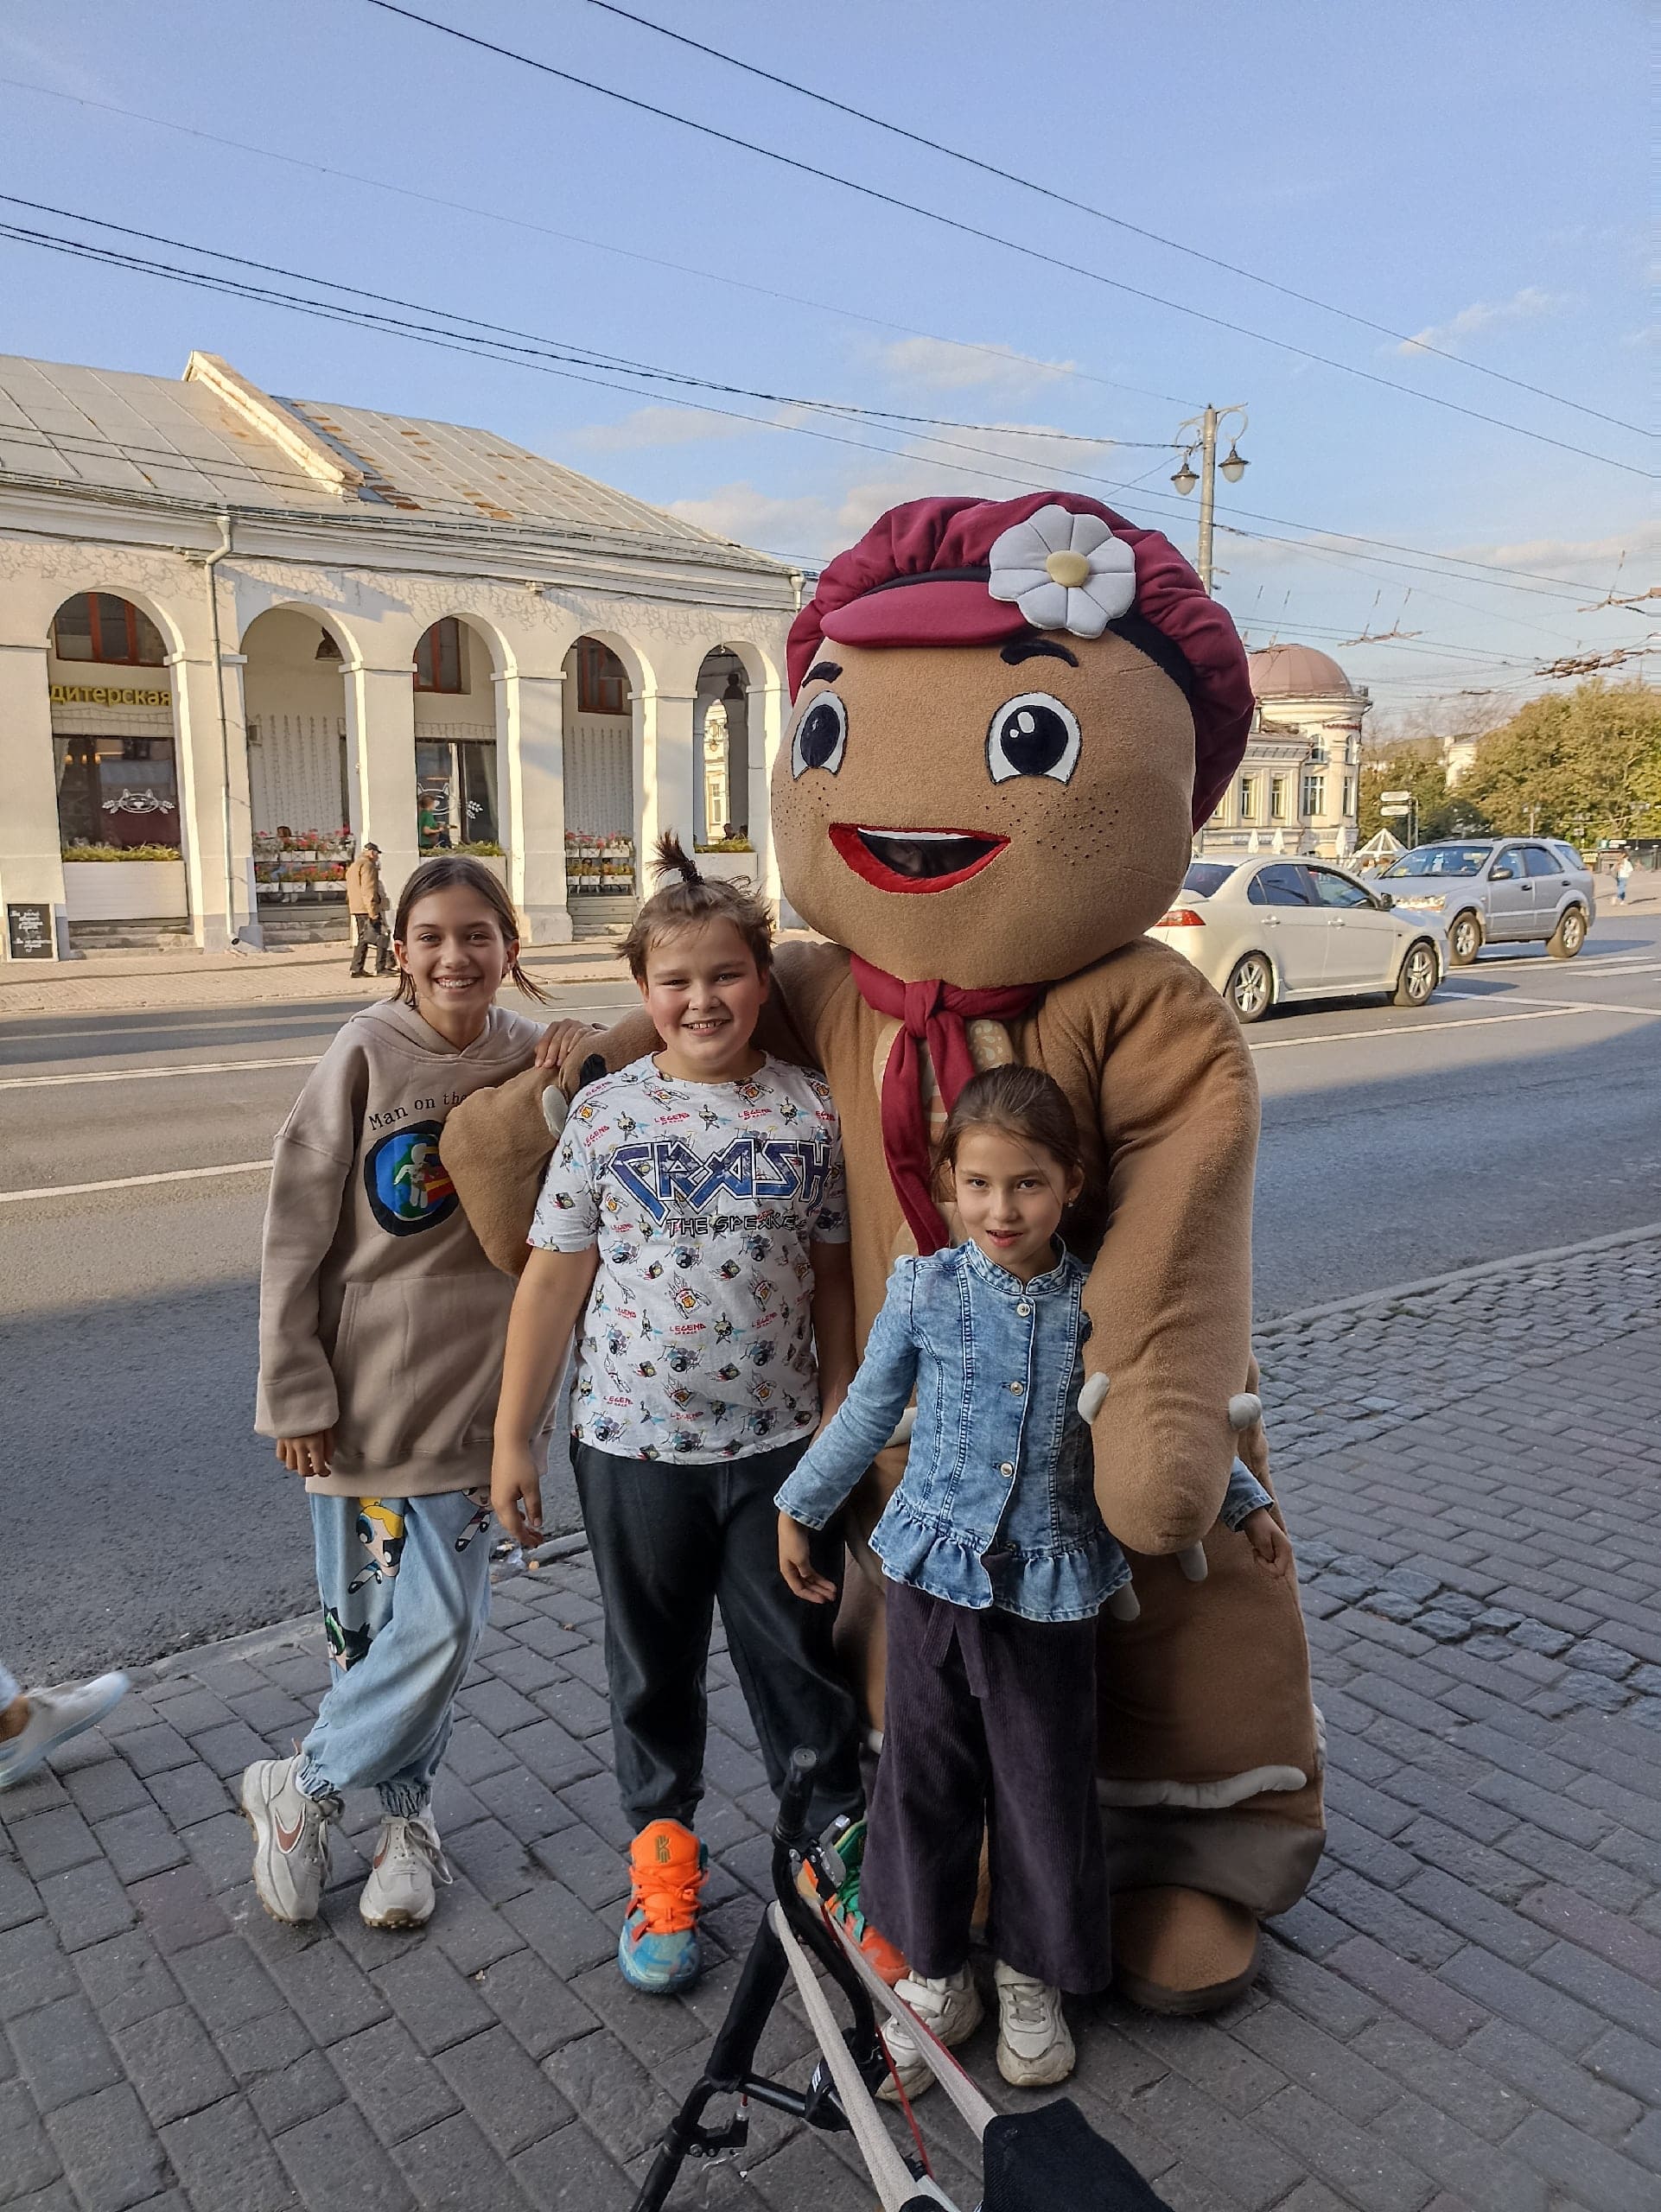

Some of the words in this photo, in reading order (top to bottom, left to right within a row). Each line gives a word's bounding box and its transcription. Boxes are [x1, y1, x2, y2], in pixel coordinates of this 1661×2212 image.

[50, 684, 171, 708] дитерская
[368, 1107, 409, 1130] Man
[414, 1098, 436, 1110] on
[665, 1217, 709, 1238] THE
[669, 1323, 707, 1332] LEGEND
